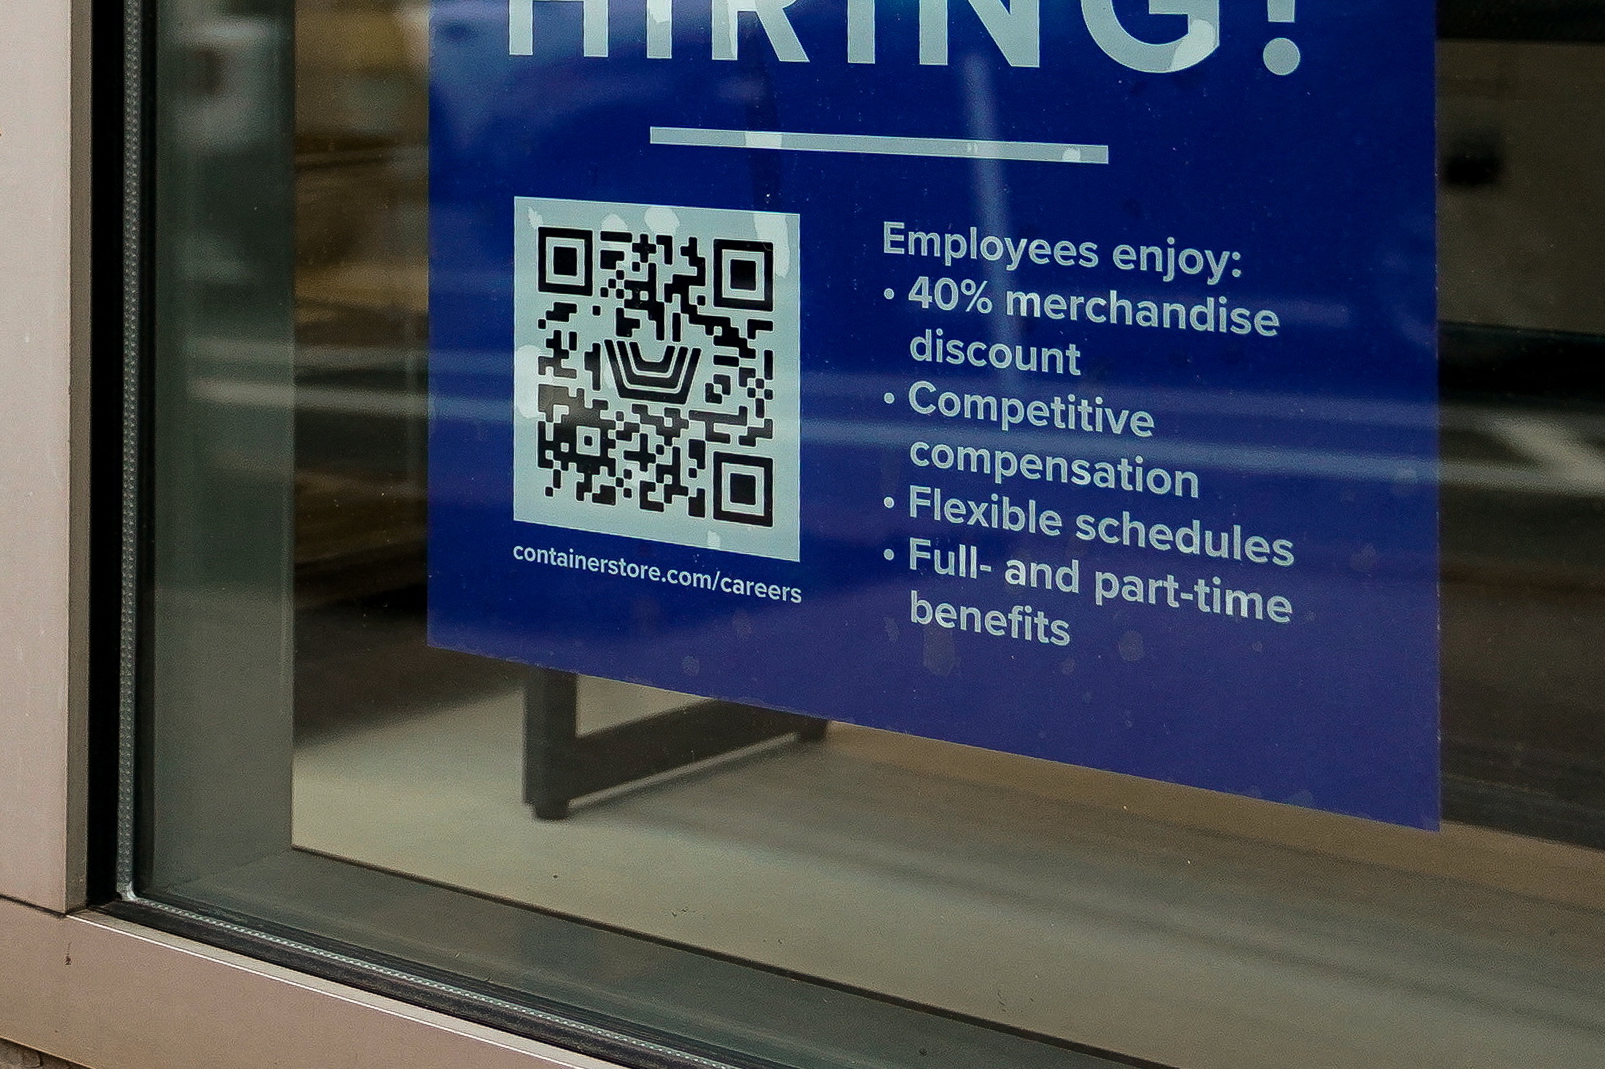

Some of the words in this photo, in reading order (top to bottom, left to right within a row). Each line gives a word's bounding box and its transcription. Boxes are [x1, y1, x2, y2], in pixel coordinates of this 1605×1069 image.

[883, 221, 1098, 271] Employees
[1112, 237, 1242, 284] enjoy:
[908, 276, 993, 314] 40%
[1005, 287, 1280, 336] merchandise
[909, 328, 1081, 376] discount
[908, 380, 1155, 437] Competitive
[909, 438, 1199, 498] compensation
[909, 485, 1063, 536] Flexible
[1075, 511, 1294, 567] schedules
[512, 543, 802, 604] containerstore.com/careers
[909, 538, 992, 580] Full-
[1004, 560, 1080, 594] and
[1094, 570, 1293, 623] part-time
[910, 591, 1071, 646] benefits
